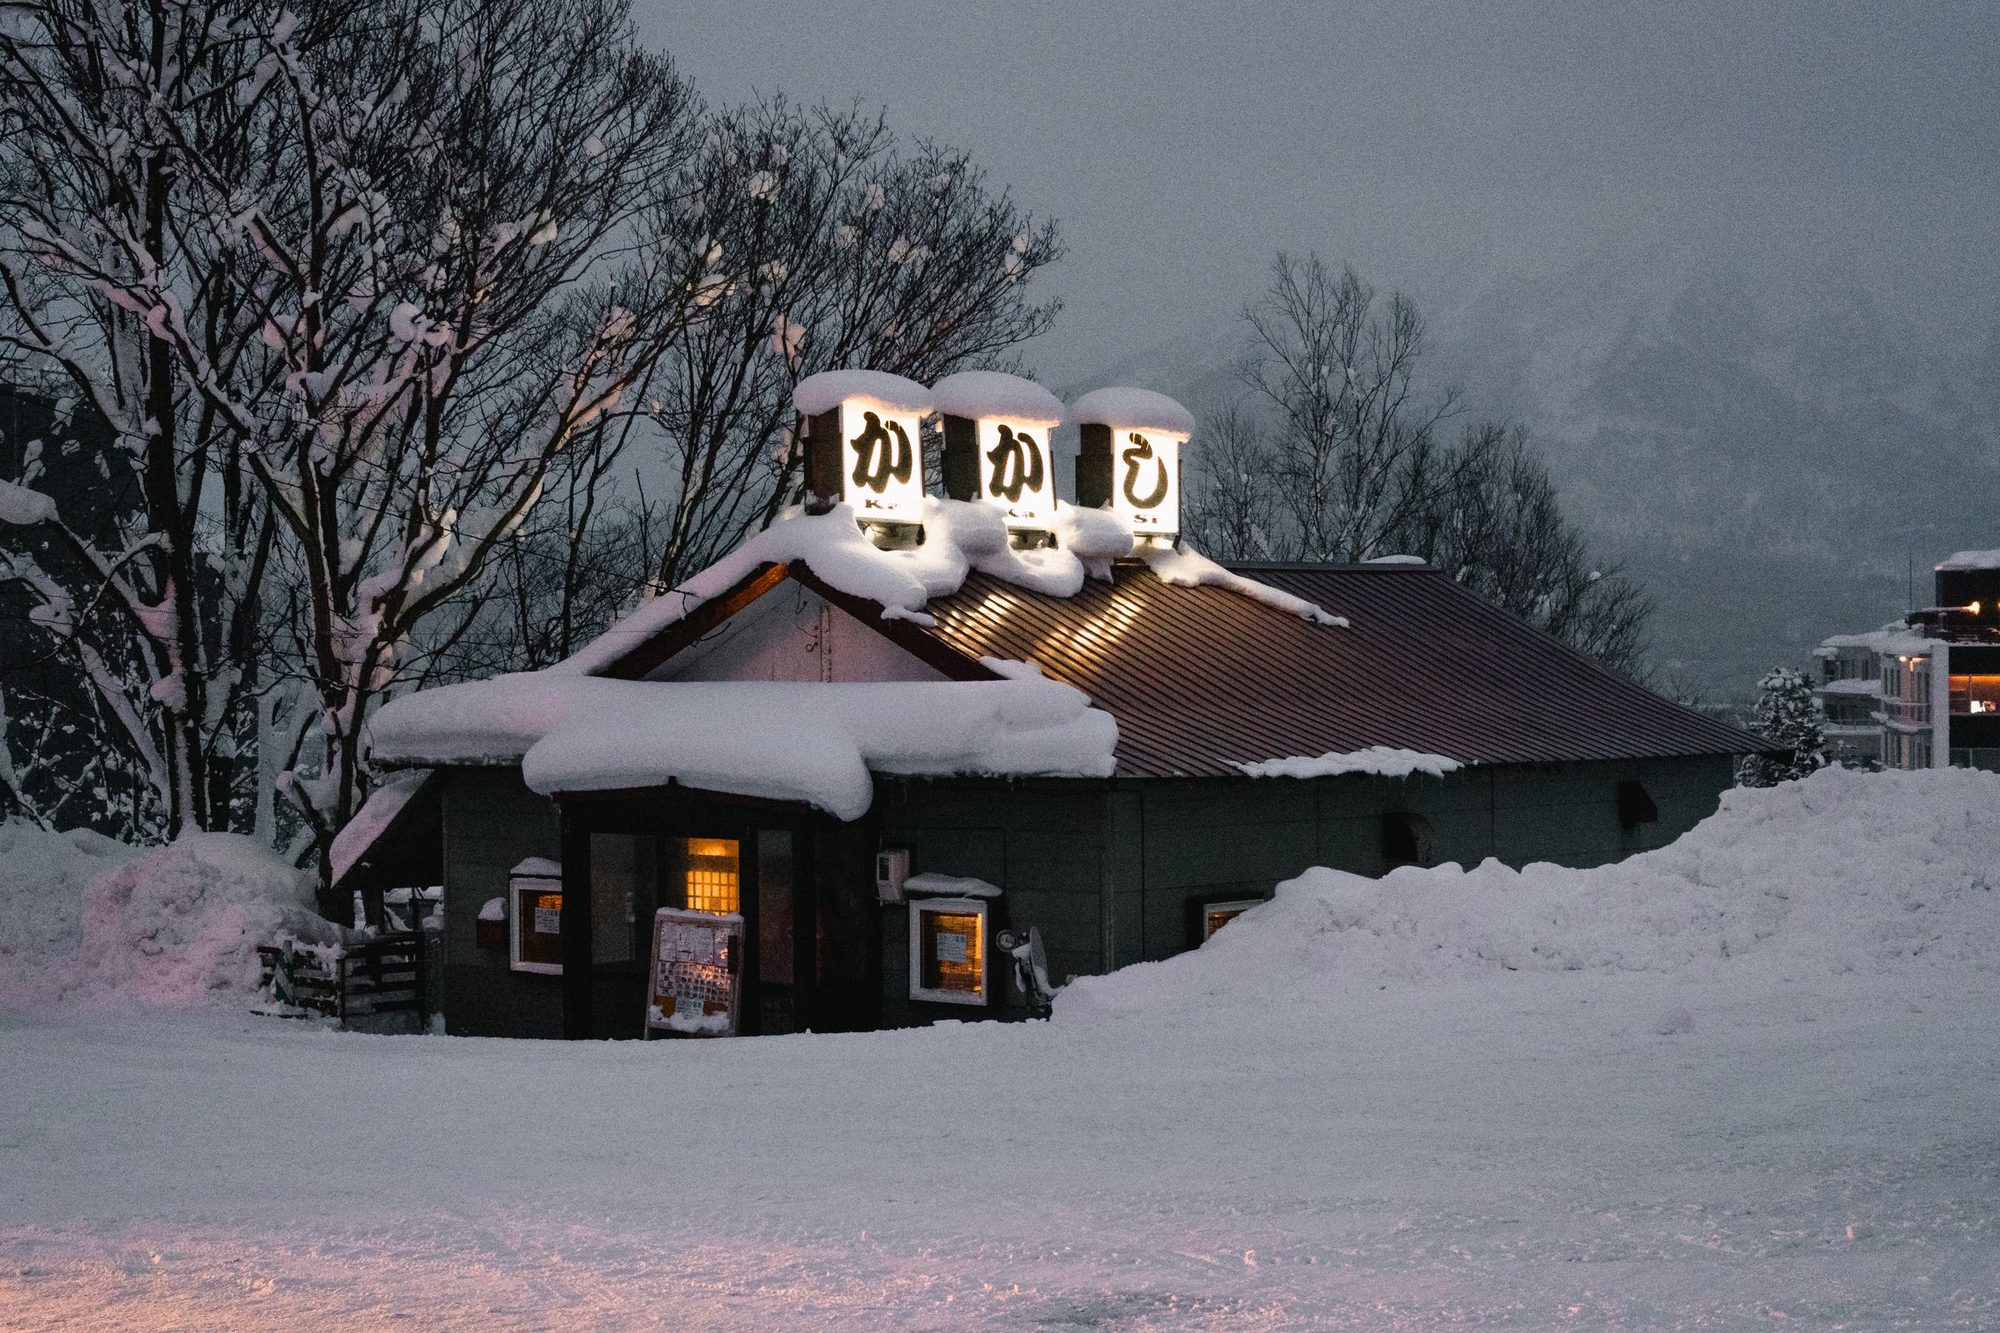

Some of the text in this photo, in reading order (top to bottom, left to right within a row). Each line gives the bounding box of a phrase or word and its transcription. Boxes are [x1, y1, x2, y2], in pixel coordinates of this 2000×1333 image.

[850, 410, 913, 493] か
[986, 423, 1044, 502] か
[864, 498, 899, 510] K
